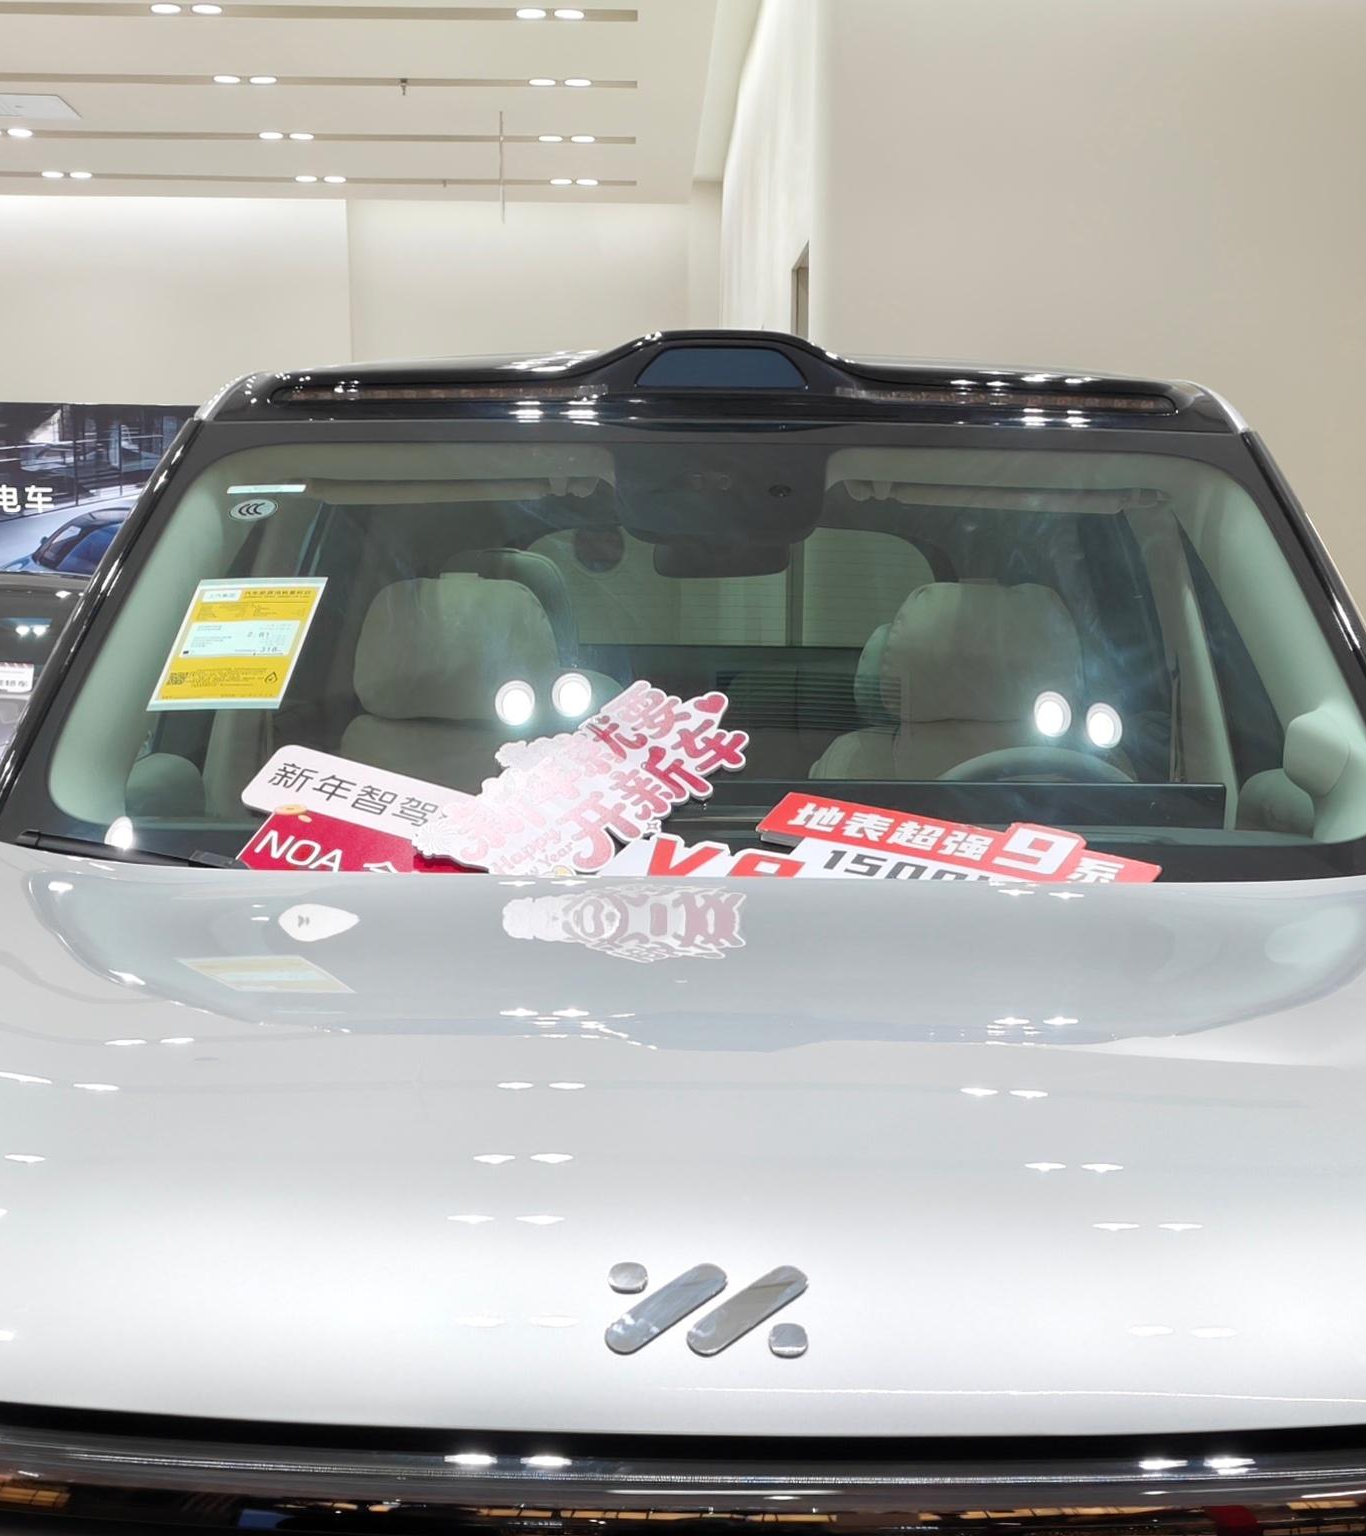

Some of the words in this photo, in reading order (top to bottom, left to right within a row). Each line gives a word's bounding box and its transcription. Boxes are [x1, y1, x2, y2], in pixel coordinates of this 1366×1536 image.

[266, 760, 443, 828] 新年智驾
[572, 718, 749, 870] 开新车
[253, 830, 343, 872] NOA
[492, 827, 563, 875] Happy
